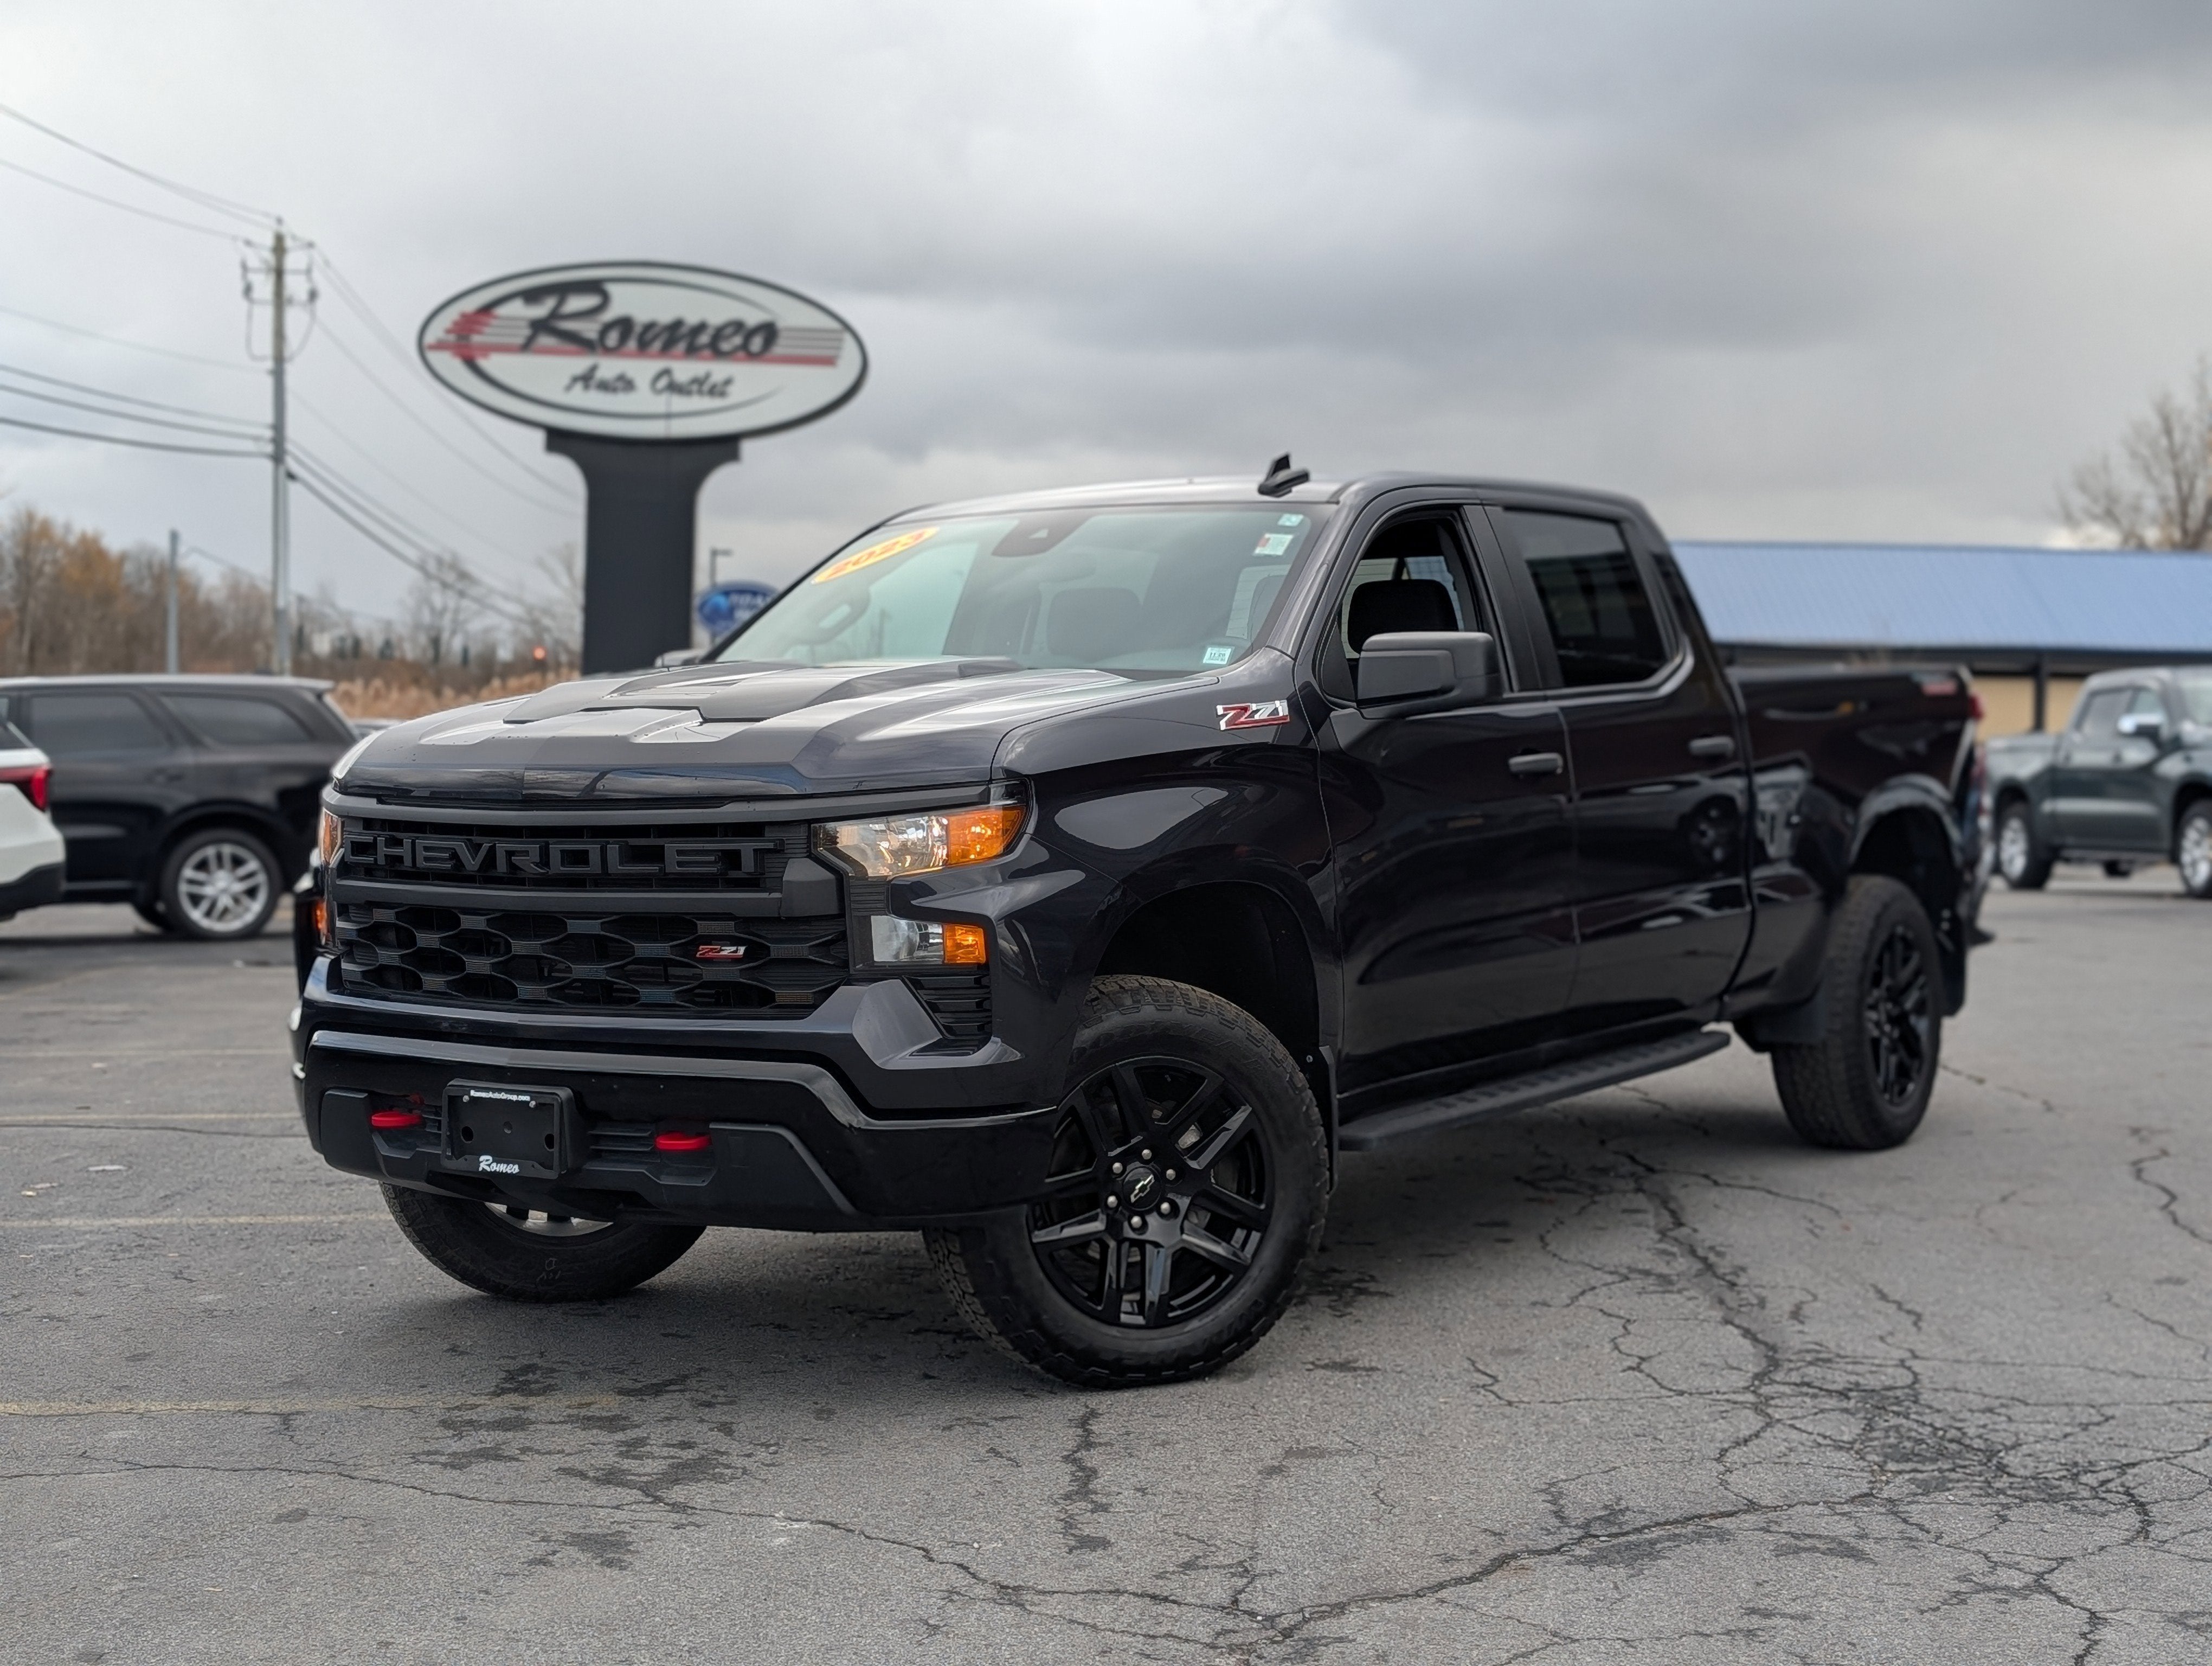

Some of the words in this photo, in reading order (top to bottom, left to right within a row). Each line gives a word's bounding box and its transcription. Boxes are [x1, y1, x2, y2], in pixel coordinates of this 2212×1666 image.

[519, 281, 780, 357] Romeo
[565, 363, 636, 395] Auto
[650, 367, 734, 399] Outlet
[1216, 700, 1290, 731] Z71
[344, 834, 780, 874] CHEVROLET
[696, 945, 748, 958] Z71
[479, 1155, 519, 1174] Romeo
